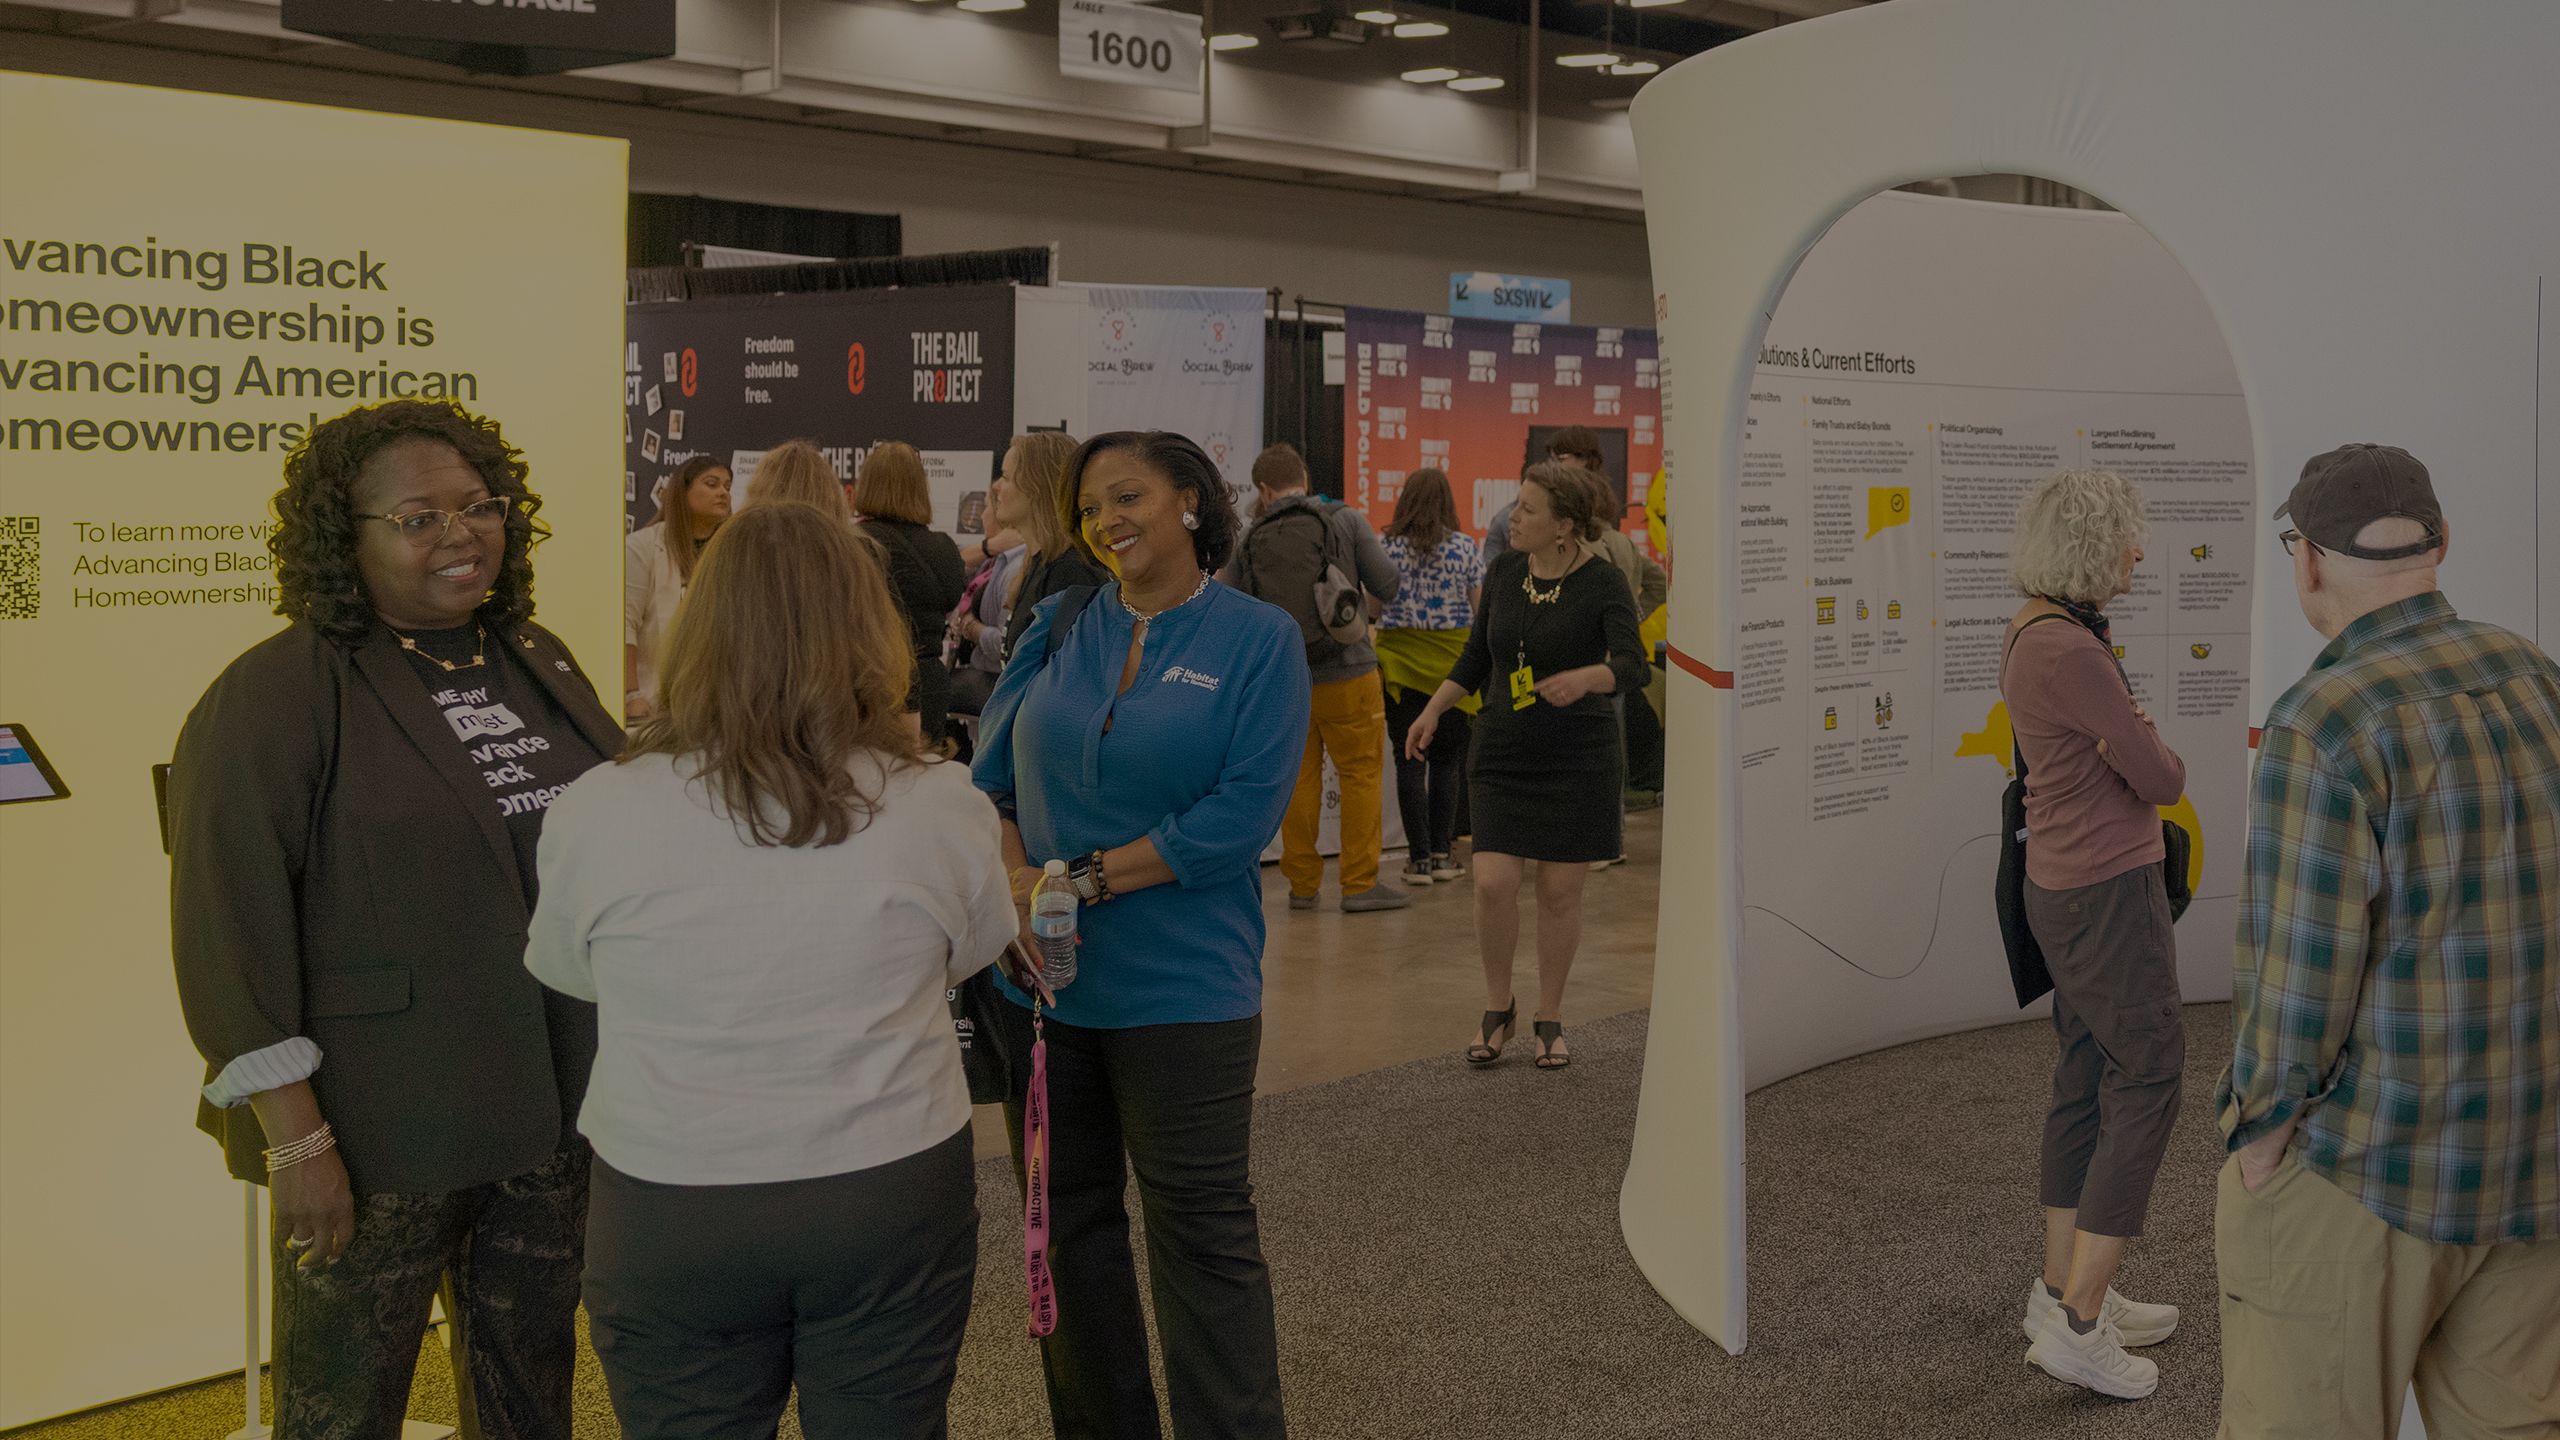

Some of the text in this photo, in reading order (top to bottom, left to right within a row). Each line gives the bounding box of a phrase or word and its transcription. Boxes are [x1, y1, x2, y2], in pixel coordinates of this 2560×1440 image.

[1088, 30, 1171, 72] 1600
[243, 243, 388, 291] Black
[1494, 287, 1537, 308] SXSW
[0, 299, 434, 352] meownership is
[745, 336, 794, 354] Freedom
[911, 331, 982, 365] THE BAIL
[745, 361, 799, 379] should be
[1801, 347, 1810, 368] &
[1813, 348, 1862, 372] Current
[1865, 352, 1916, 375] Efforts
[234, 356, 477, 401] American
[913, 369, 982, 403] PROJECT
[1357, 342, 1371, 415] BUILD
[745, 386, 772, 404] free.
[1812, 396, 1851, 407] National Efforts
[1812, 419, 1828, 431] Family
[1857, 420, 1871, 432] Baby
[1872, 421, 1891, 431] Bonds
[1940, 423, 2003, 436] Political Organizing
[2091, 429, 2155, 440] Largest Redlining
[2092, 441, 2175, 451] Settlement Agreement
[930, 470, 954, 479] SYSTEM
[73, 522, 105, 543] To
[112, 522, 174, 542] learn
[181, 524, 244, 541] more
[1943, 550, 1979, 561] Community
[73, 553, 208, 577] Advancing
[1829, 577, 1852, 586] Business
[1945, 618, 1962, 628] Legal
[1962, 617, 1982, 626] Action
[1184, 669, 1220, 686] Habitat
[1031, 1157, 1042, 1230] INTERACTIVE
